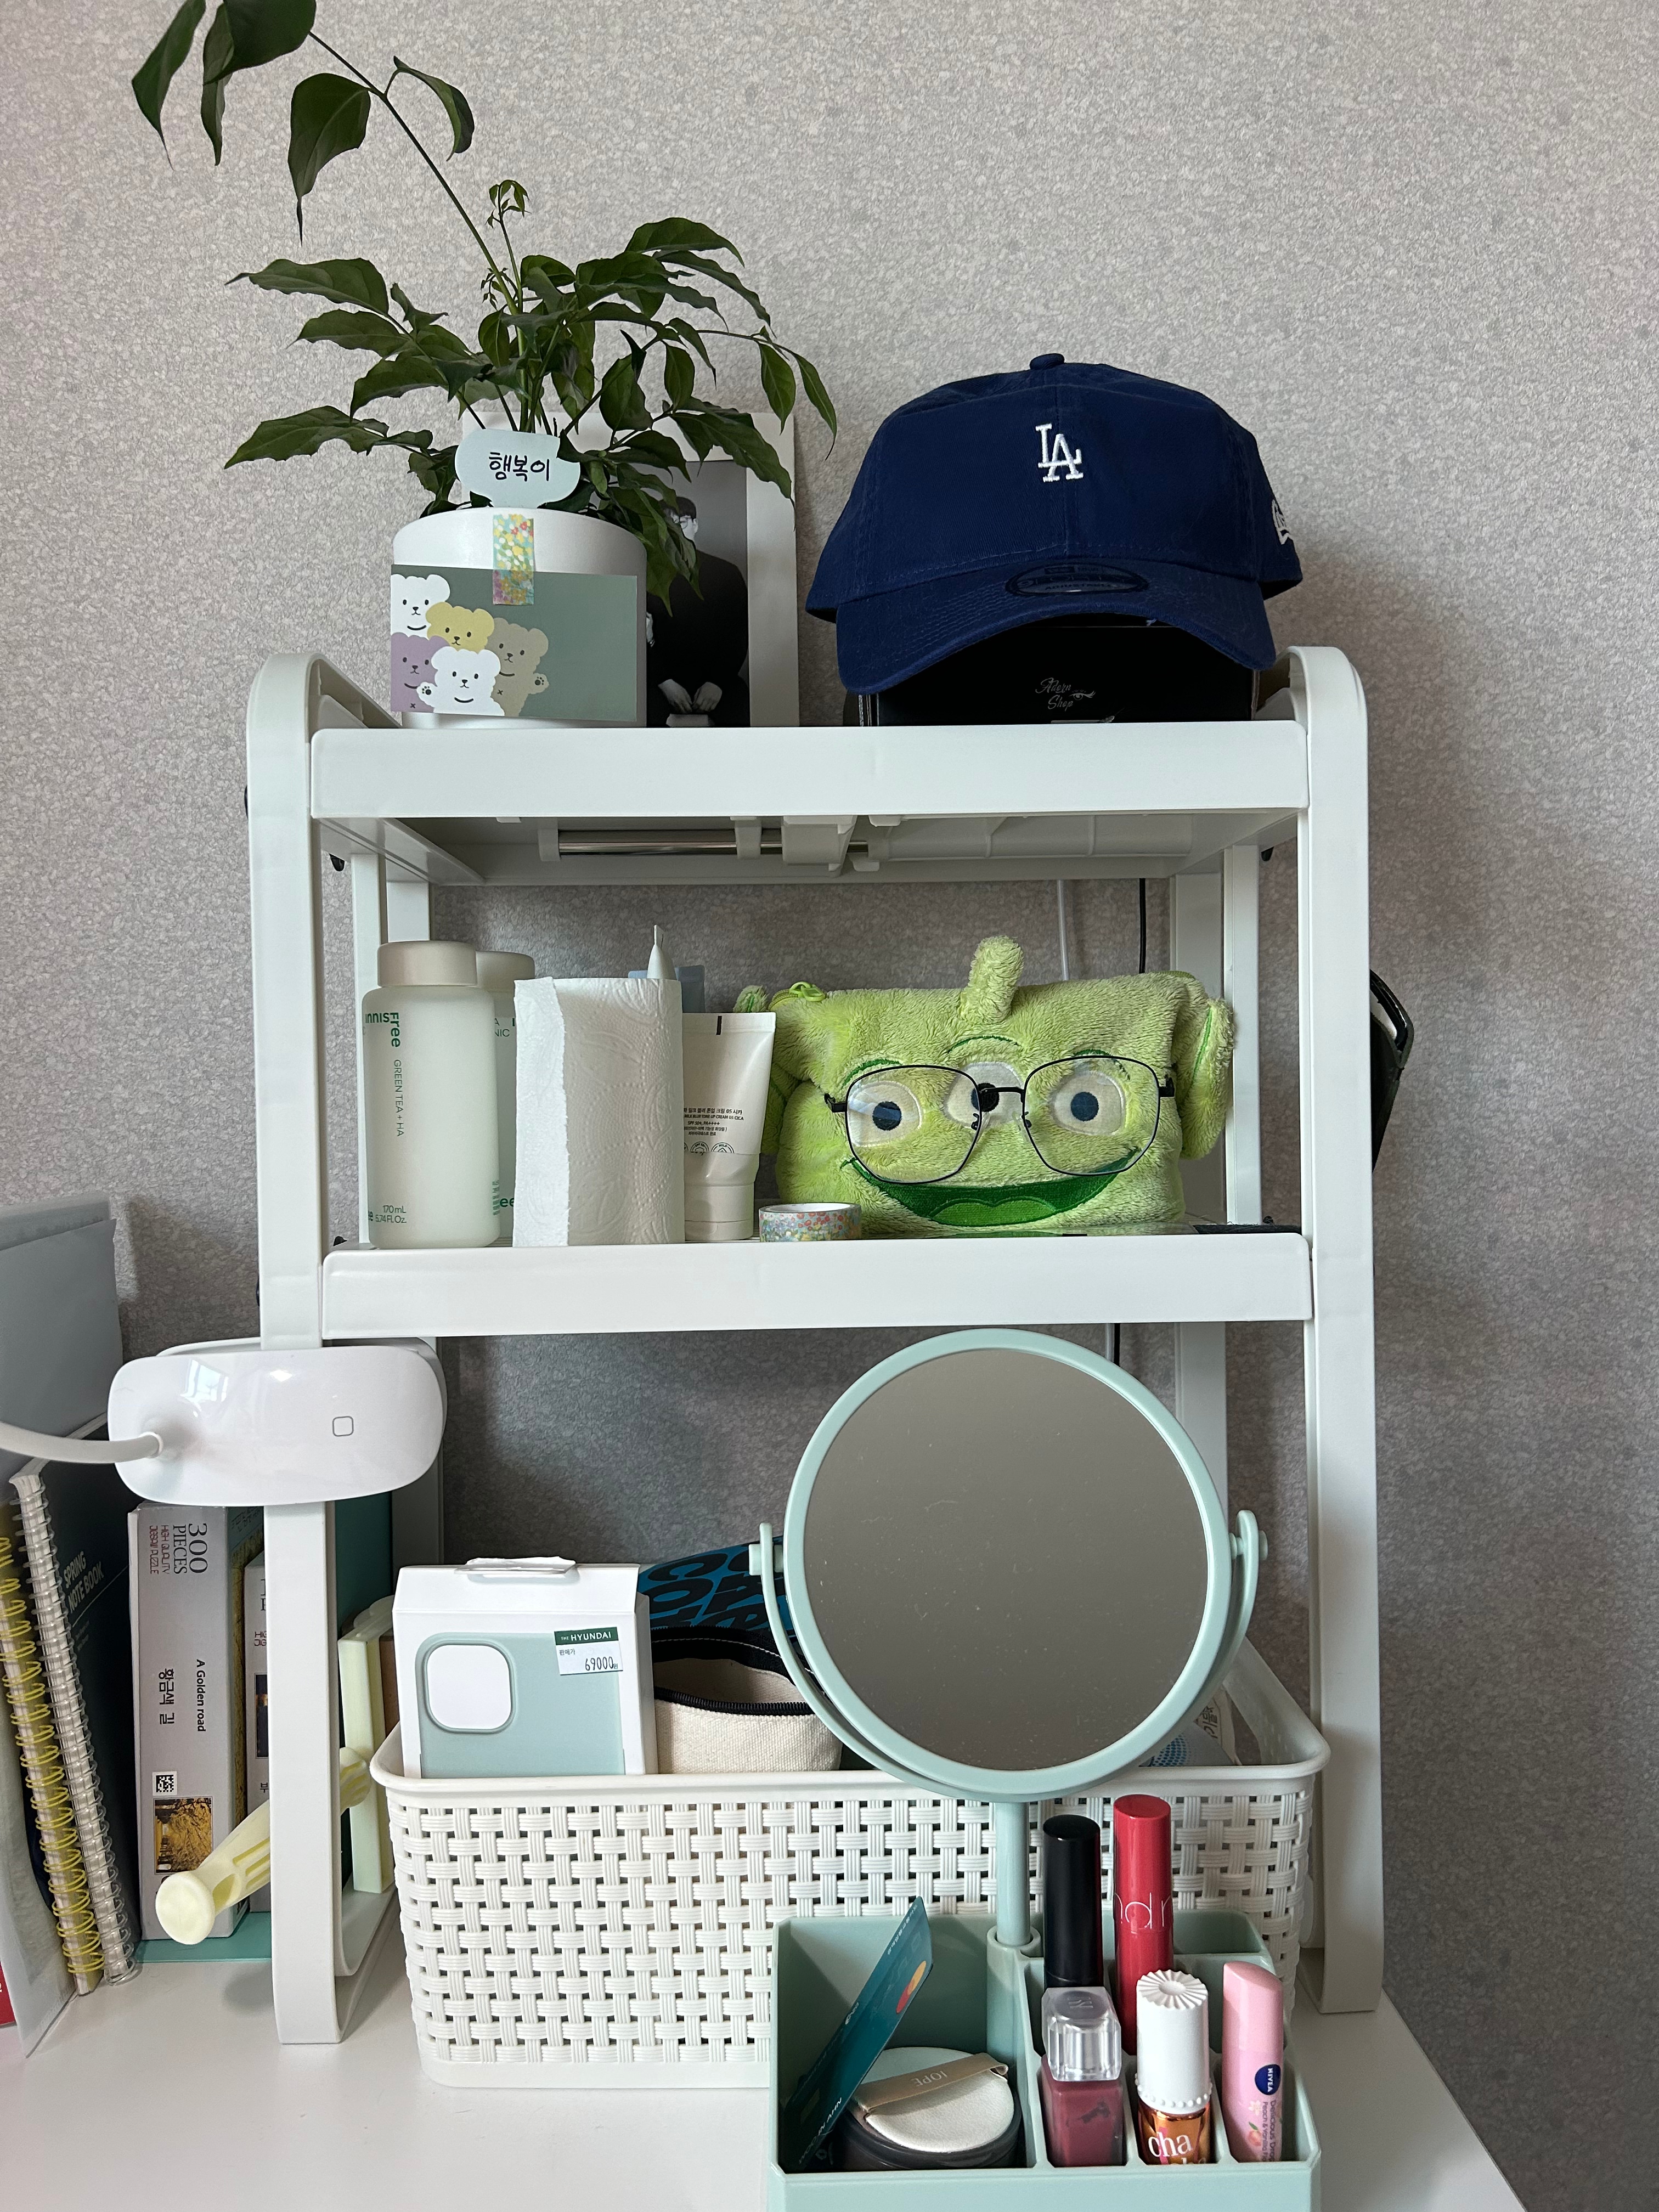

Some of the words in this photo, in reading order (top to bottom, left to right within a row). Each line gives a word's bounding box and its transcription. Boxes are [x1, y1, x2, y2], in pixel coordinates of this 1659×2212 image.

[1036, 423, 1084, 483] LA
[488, 452, 550, 482] 행복이
[1047, 694, 1074, 712] Shop
[393, 1059, 403, 1092] GREEN
[395, 1094, 404, 1113] TEA
[396, 1122, 405, 1137] HA
[161, 1525, 170, 1542] HIGH
[161, 1544, 170, 1575] QUALITY
[173, 1525, 187, 1575] PIECES
[188, 1523, 208, 1573] 300
[63, 1550, 87, 1589] SPRING
[150, 1550, 159, 1575] PUZZLE
[67, 1580, 85, 1614] NOTE
[83, 1561, 105, 1594] BOOK
[571, 1632, 611, 1641] HYUNDAI
[196, 1659, 205, 1667] A
[159, 1668, 174, 1705] 황금색
[196, 1670, 205, 1706] Golden
[159, 1712, 174, 1725] 길
[197, 1708, 206, 1731] road
[910, 2070, 948, 2086] IOPE
[1148, 2131, 1193, 2157] cha
